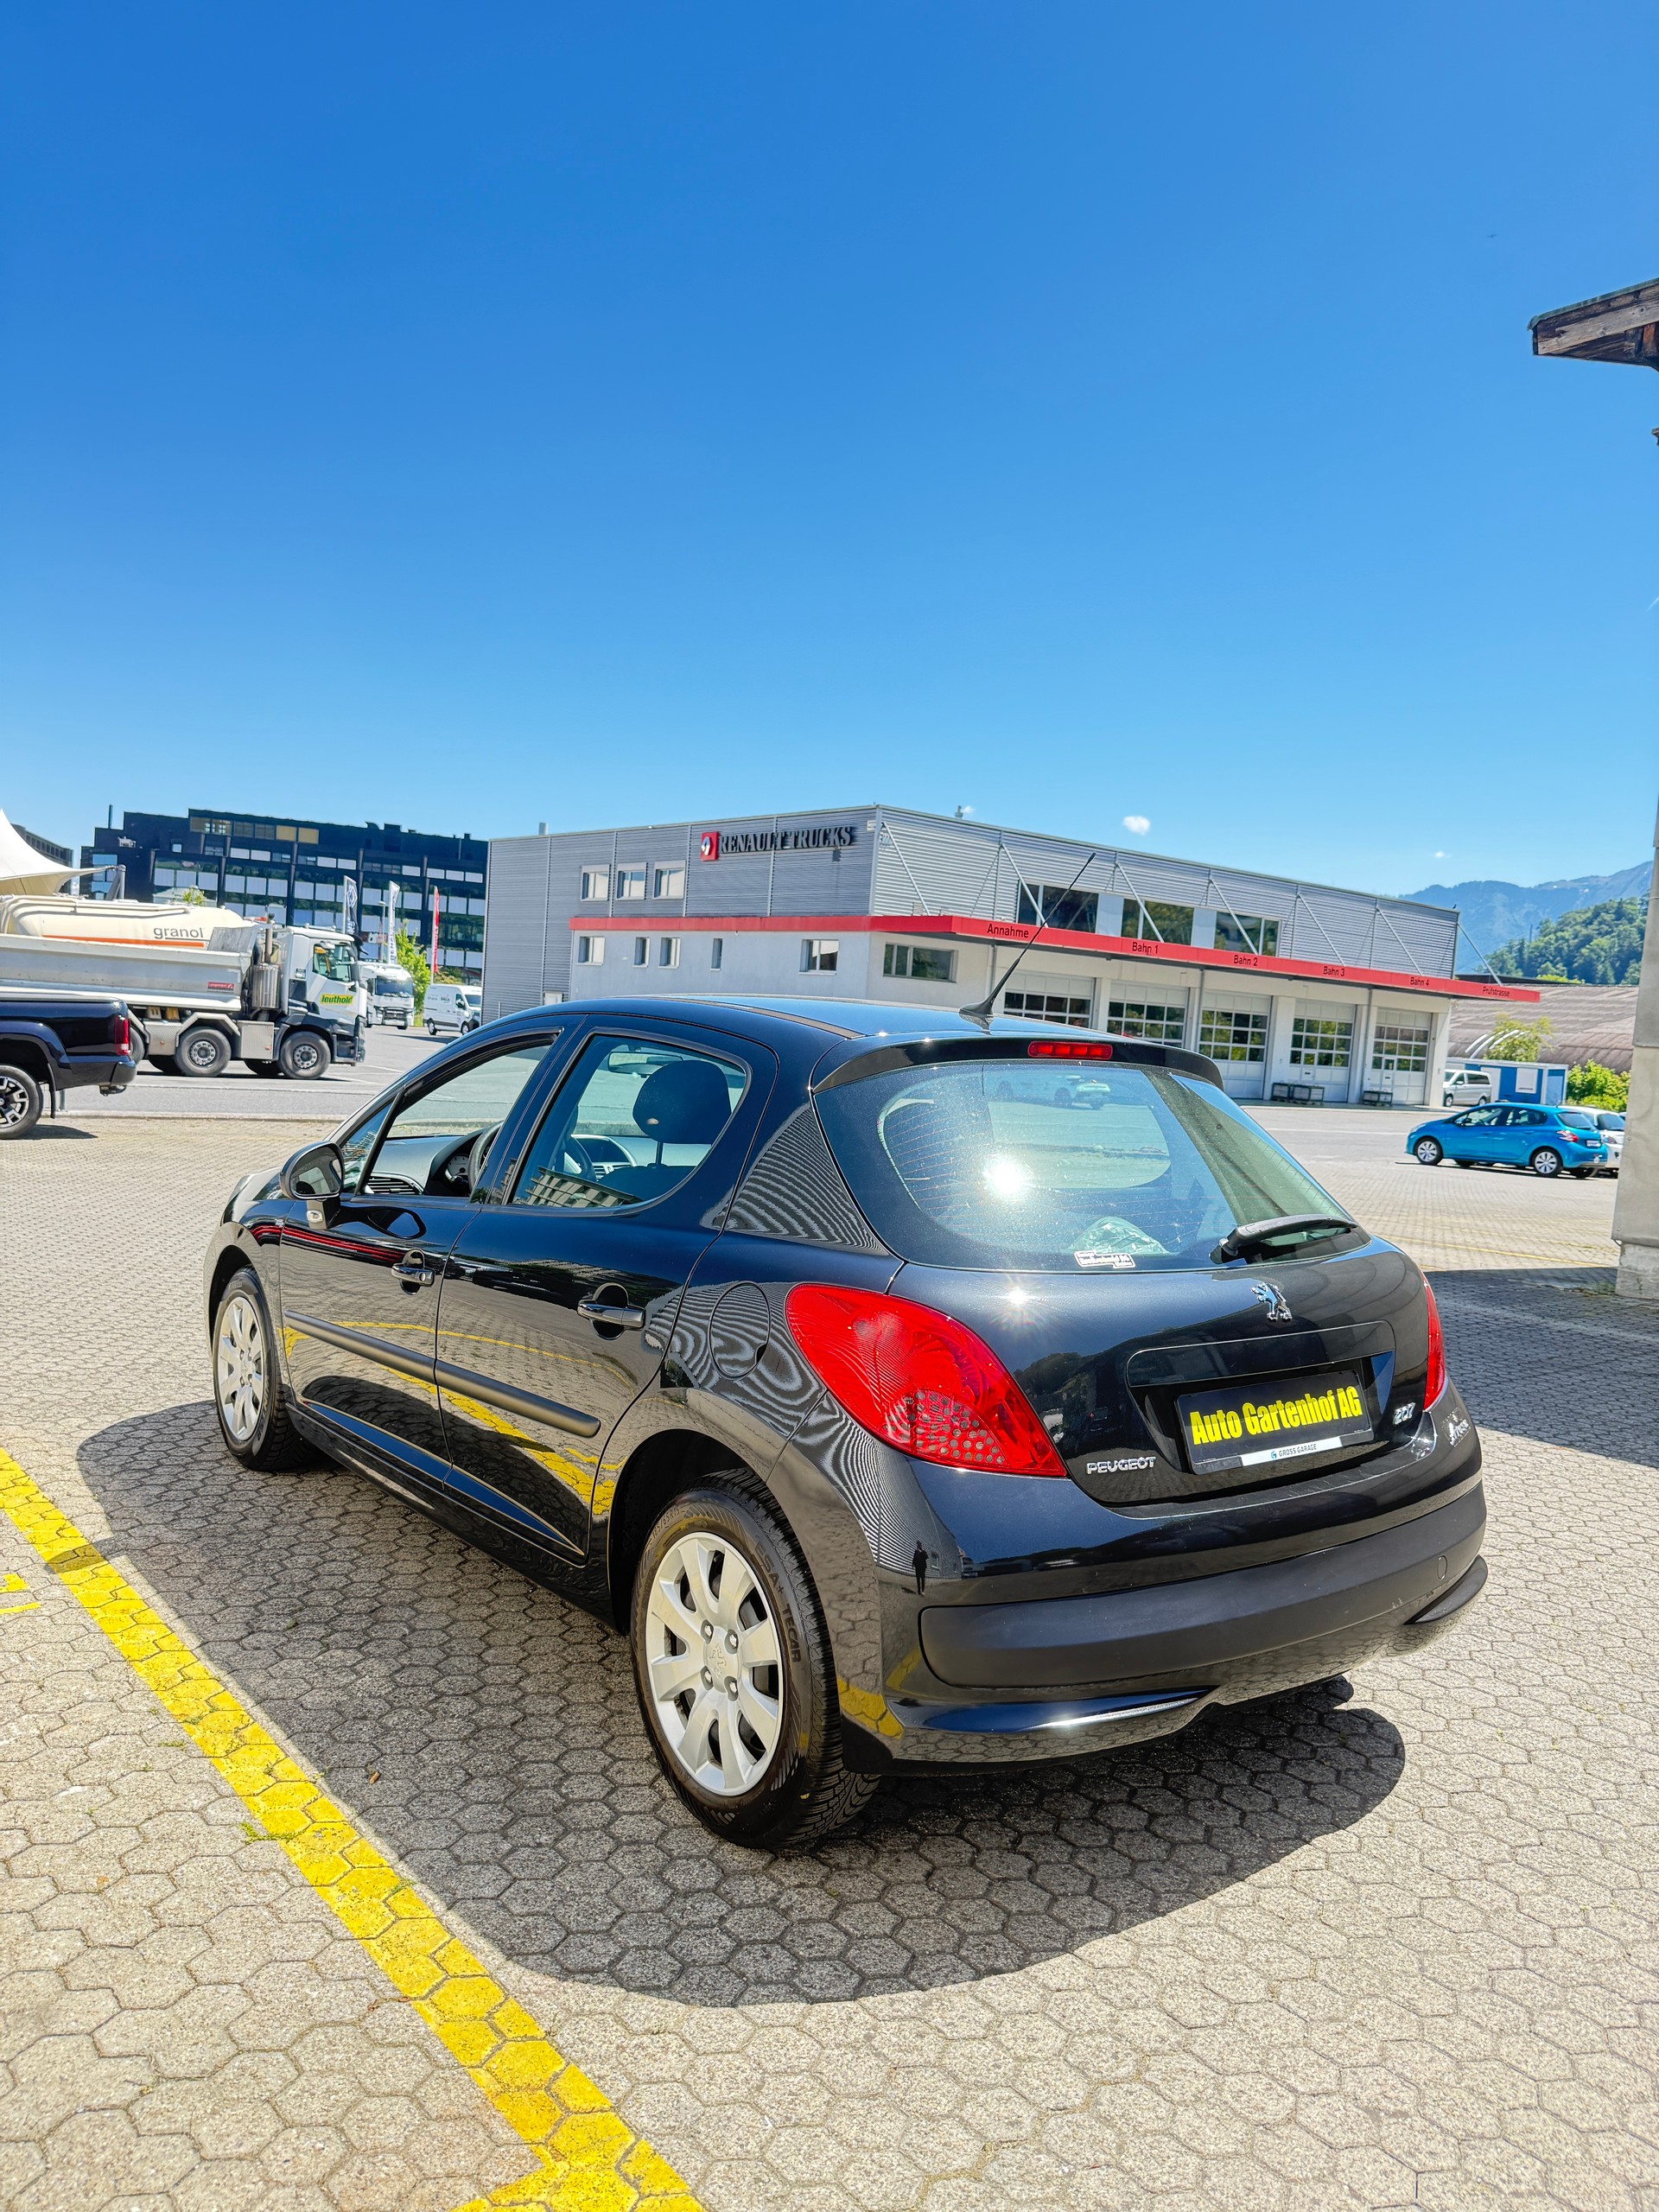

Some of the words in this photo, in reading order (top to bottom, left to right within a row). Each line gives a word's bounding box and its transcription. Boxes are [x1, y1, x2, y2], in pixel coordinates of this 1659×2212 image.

[719, 831, 785, 855] RENAULT
[788, 826, 853, 849] TRUCKS
[153, 927, 204, 939] granol
[987, 924, 1029, 938] Annahme
[1132, 942, 1153, 955] Bahn
[1154, 944, 1159, 954] 1
[1234, 955, 1251, 966] Bahn
[1253, 957, 1258, 967] 2
[1324, 966, 1339, 976] Bahn
[1341, 968, 1345, 976] 3
[1410, 976, 1425, 987] Bahn
[1189, 1409, 1243, 1446] Auto
[1242, 1389, 1339, 1436] Gartenhof
[1337, 1386, 1363, 1420] AG
[1279, 1447, 1296, 1457] GROSS
[1297, 1443, 1317, 1452] GARAGE
[1086, 1456, 1156, 1475] PEUGEOT
